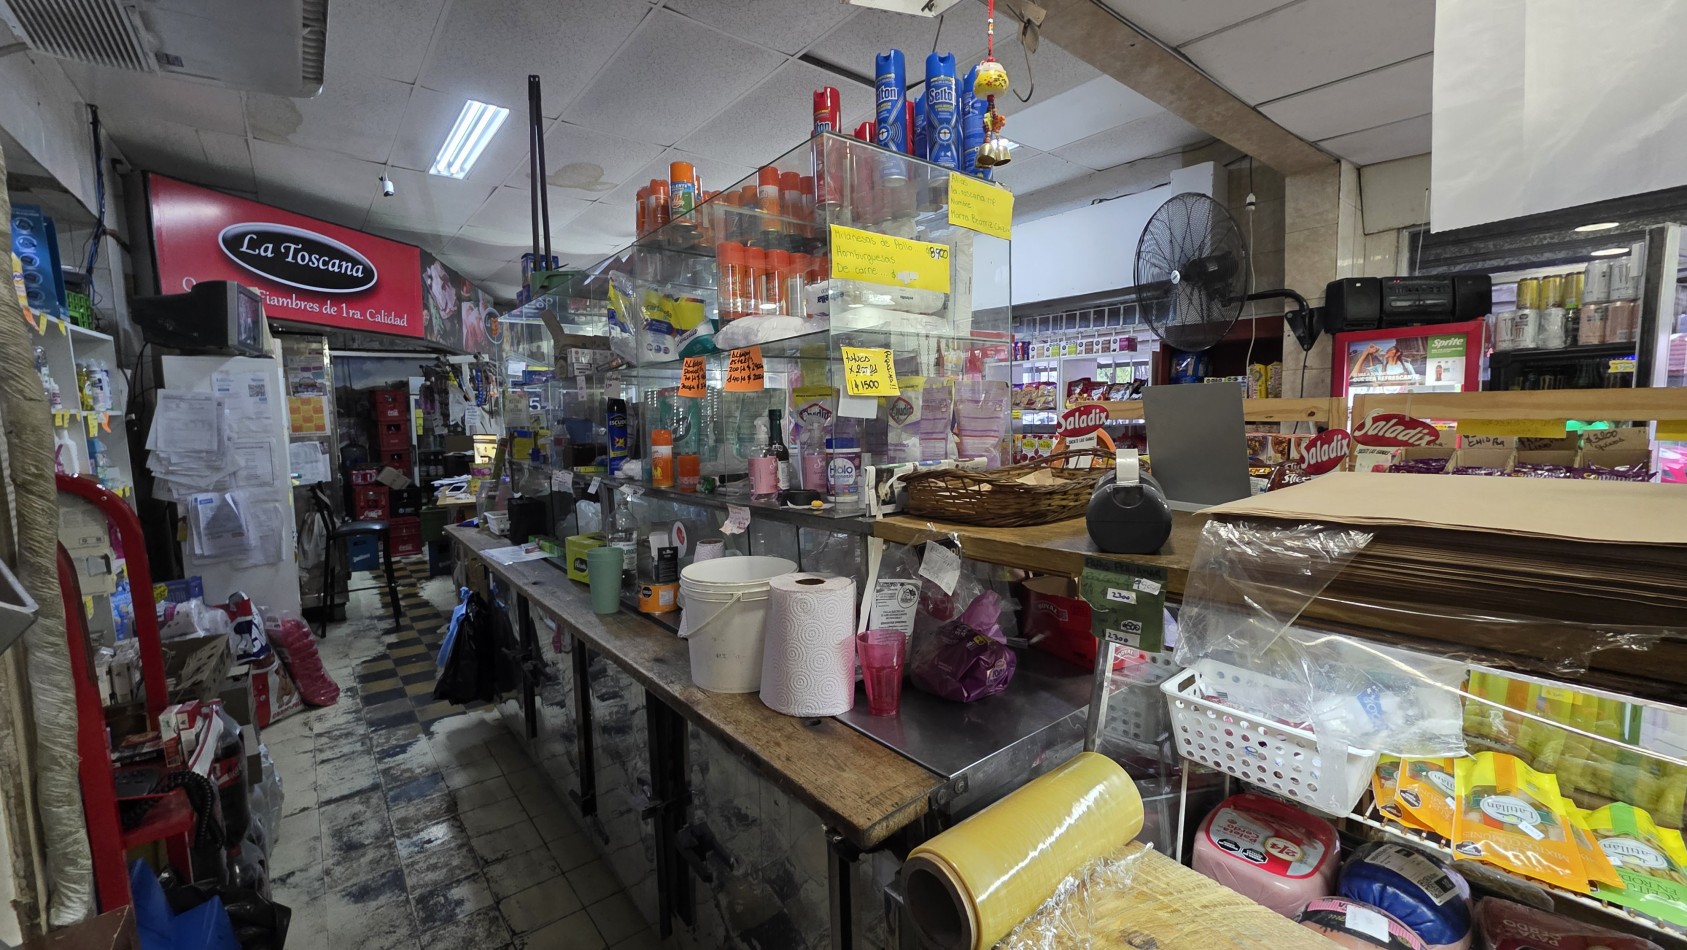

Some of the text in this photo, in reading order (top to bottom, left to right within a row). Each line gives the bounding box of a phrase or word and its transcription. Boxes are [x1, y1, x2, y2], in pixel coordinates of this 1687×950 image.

[929, 86, 956, 104] Selto
[835, 230, 877, 246] Milanesas
[880, 237, 890, 248] de
[240, 234, 365, 278] La Toscana
[836, 245, 896, 265] Hamburguesas
[837, 263, 848, 274] De
[259, 289, 408, 328] Fiambres de 1ra. Calidad
[1432, 337, 1464, 349] Sprite
[1057, 409, 1107, 433] Saladix
[1353, 408, 1436, 447] Saladix
[1300, 434, 1350, 465] Saladix
[1112, 591, 1131, 600] 2300
[1107, 632, 1129, 643] 2300
[1486, 801, 1534, 820] Latillán
[1223, 828, 1257, 844] Paleta
[1226, 823, 1260, 839] Cerdo
[1603, 843, 1658, 862] Latillán
[1620, 871, 1678, 895] EN ROD
